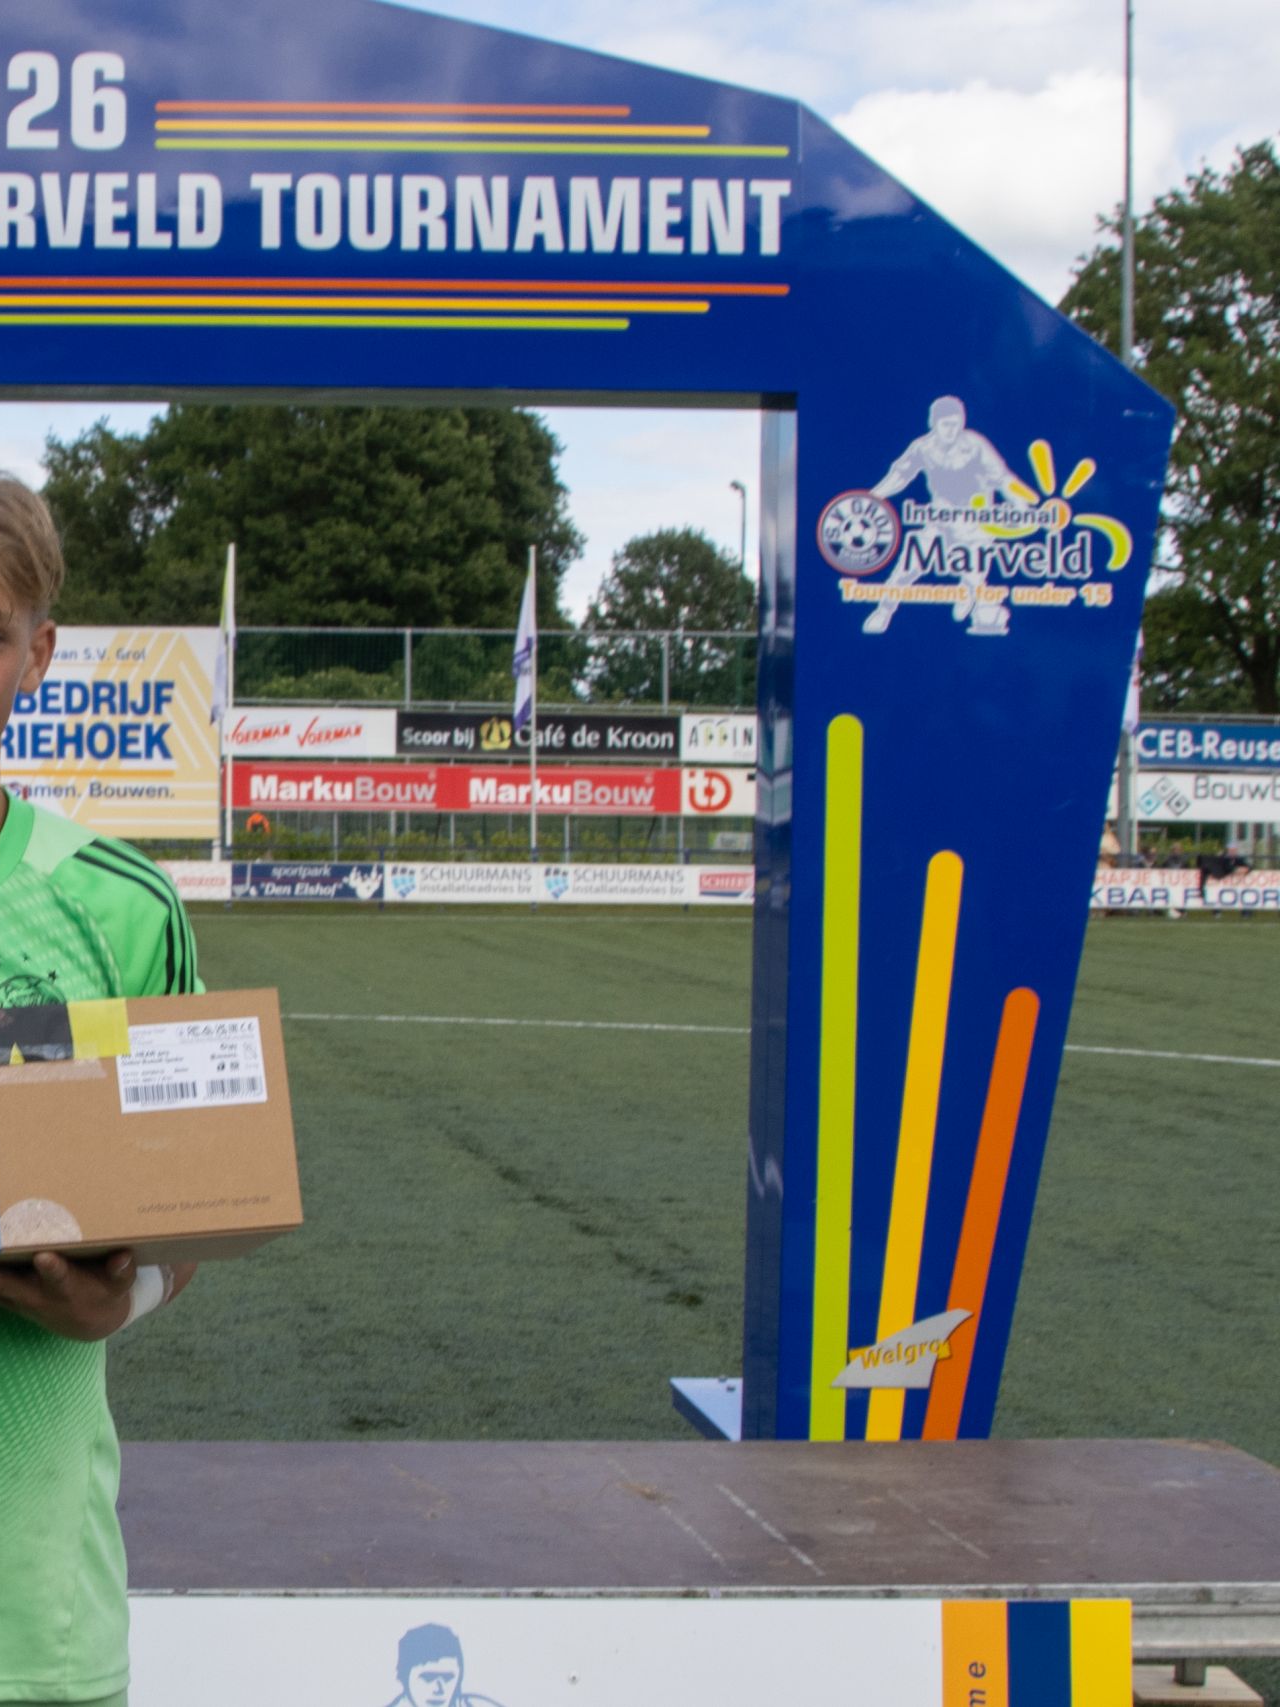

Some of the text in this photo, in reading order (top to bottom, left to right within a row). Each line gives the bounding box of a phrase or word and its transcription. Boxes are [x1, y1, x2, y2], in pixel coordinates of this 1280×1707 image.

[249, 172, 792, 255] TOURNAMENT
[904, 501, 1058, 526] International
[904, 531, 1092, 579] Marveld
[840, 578, 1113, 607] Tournament for under 15
[116, 648, 146, 661] Grol
[12, 680, 174, 715] BEDRIJF
[402, 724, 675, 749] Scoor bij Café de Kroon
[89, 782, 176, 799] Bouwen.
[250, 774, 437, 802] MarkuBouw
[469, 777, 655, 806] MarkuBouw
[271, 864, 332, 880] sportpark
[420, 867, 533, 883] SCHUURMANS
[573, 867, 685, 883] SCHUURMANS
